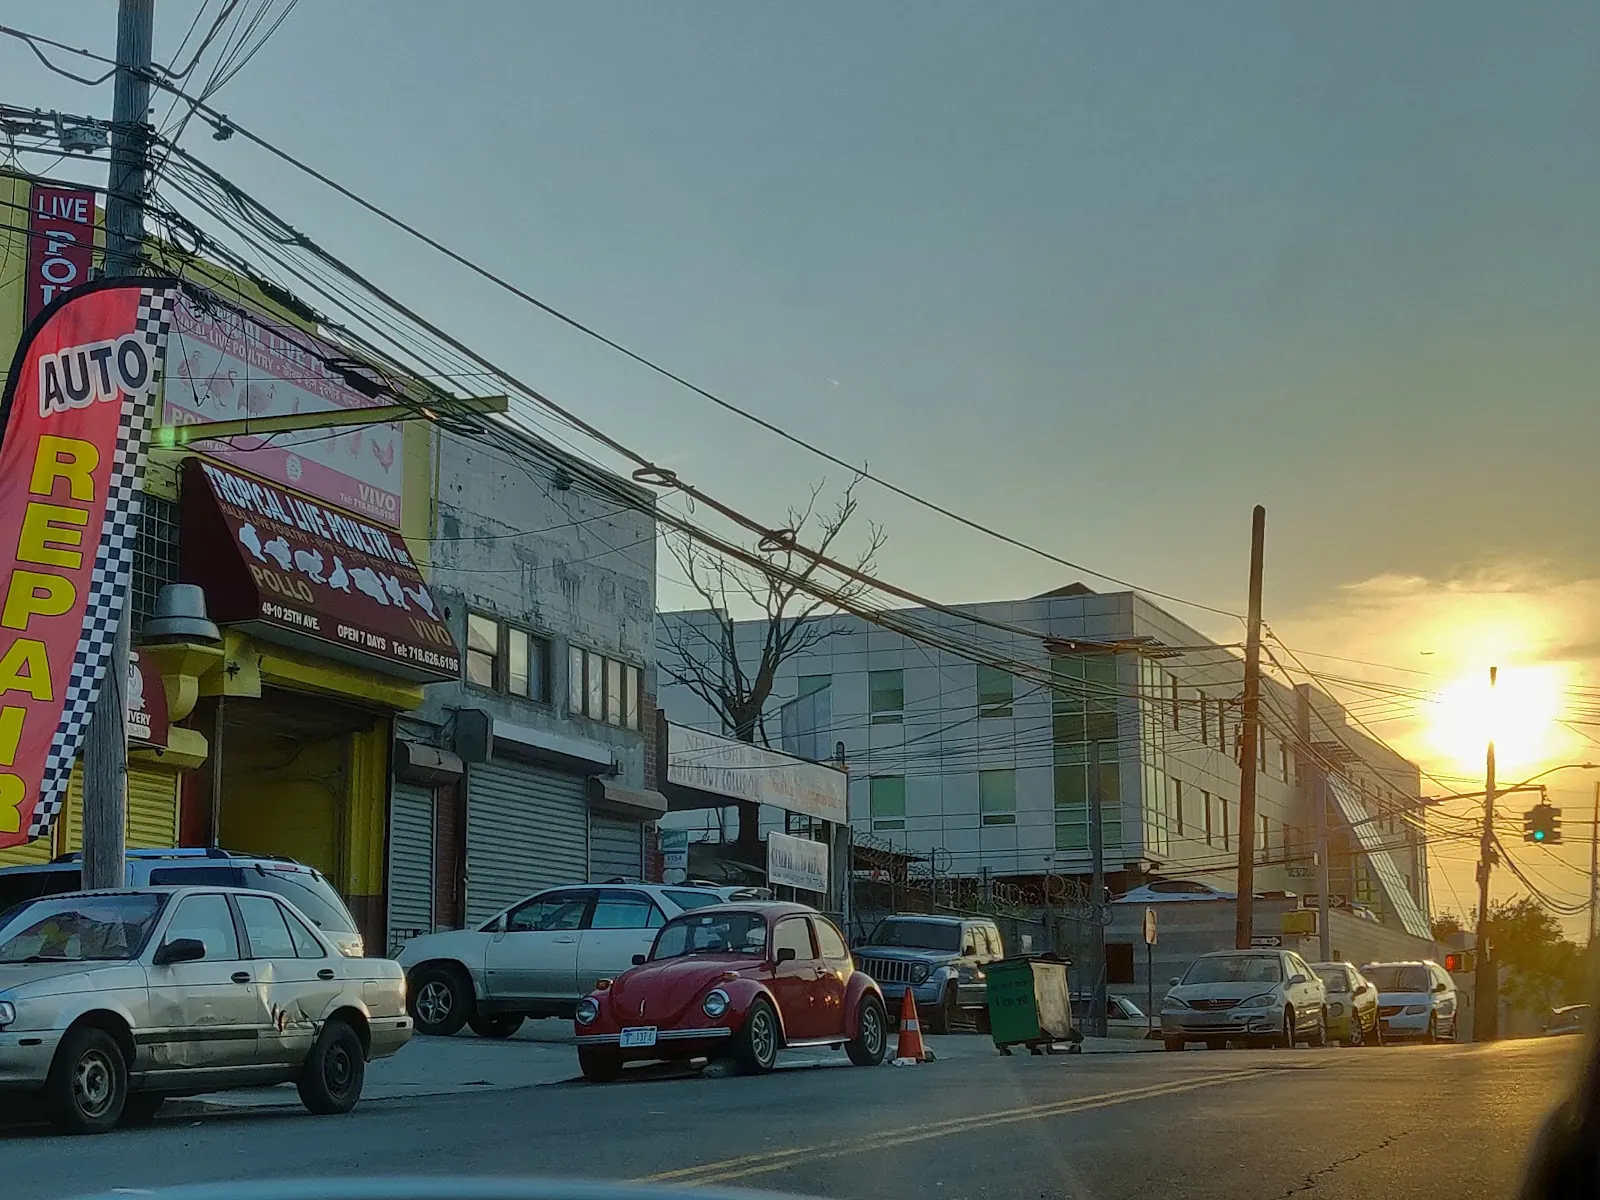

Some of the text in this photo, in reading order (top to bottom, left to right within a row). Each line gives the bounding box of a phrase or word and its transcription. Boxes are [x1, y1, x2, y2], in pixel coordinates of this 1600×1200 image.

[38, 194, 88, 223] LIVE
[209, 332, 232, 351] LIVE
[233, 341, 275, 371] POULTRY
[42, 338, 150, 412] AUTO
[201, 462, 293, 525] TROPICAL
[286, 494, 332, 541] LIVE
[323, 509, 399, 565] POULTRY
[358, 483, 397, 512] VIVO
[248, 562, 453, 648] POLLO VIVO
[261, 601, 321, 631] 49-10 25TH AVE.
[0, 434, 100, 834] REPAIR
[337, 623, 388, 651] OPEN 7 DAYS
[391, 641, 459, 672] Tel: 718.626.6196
